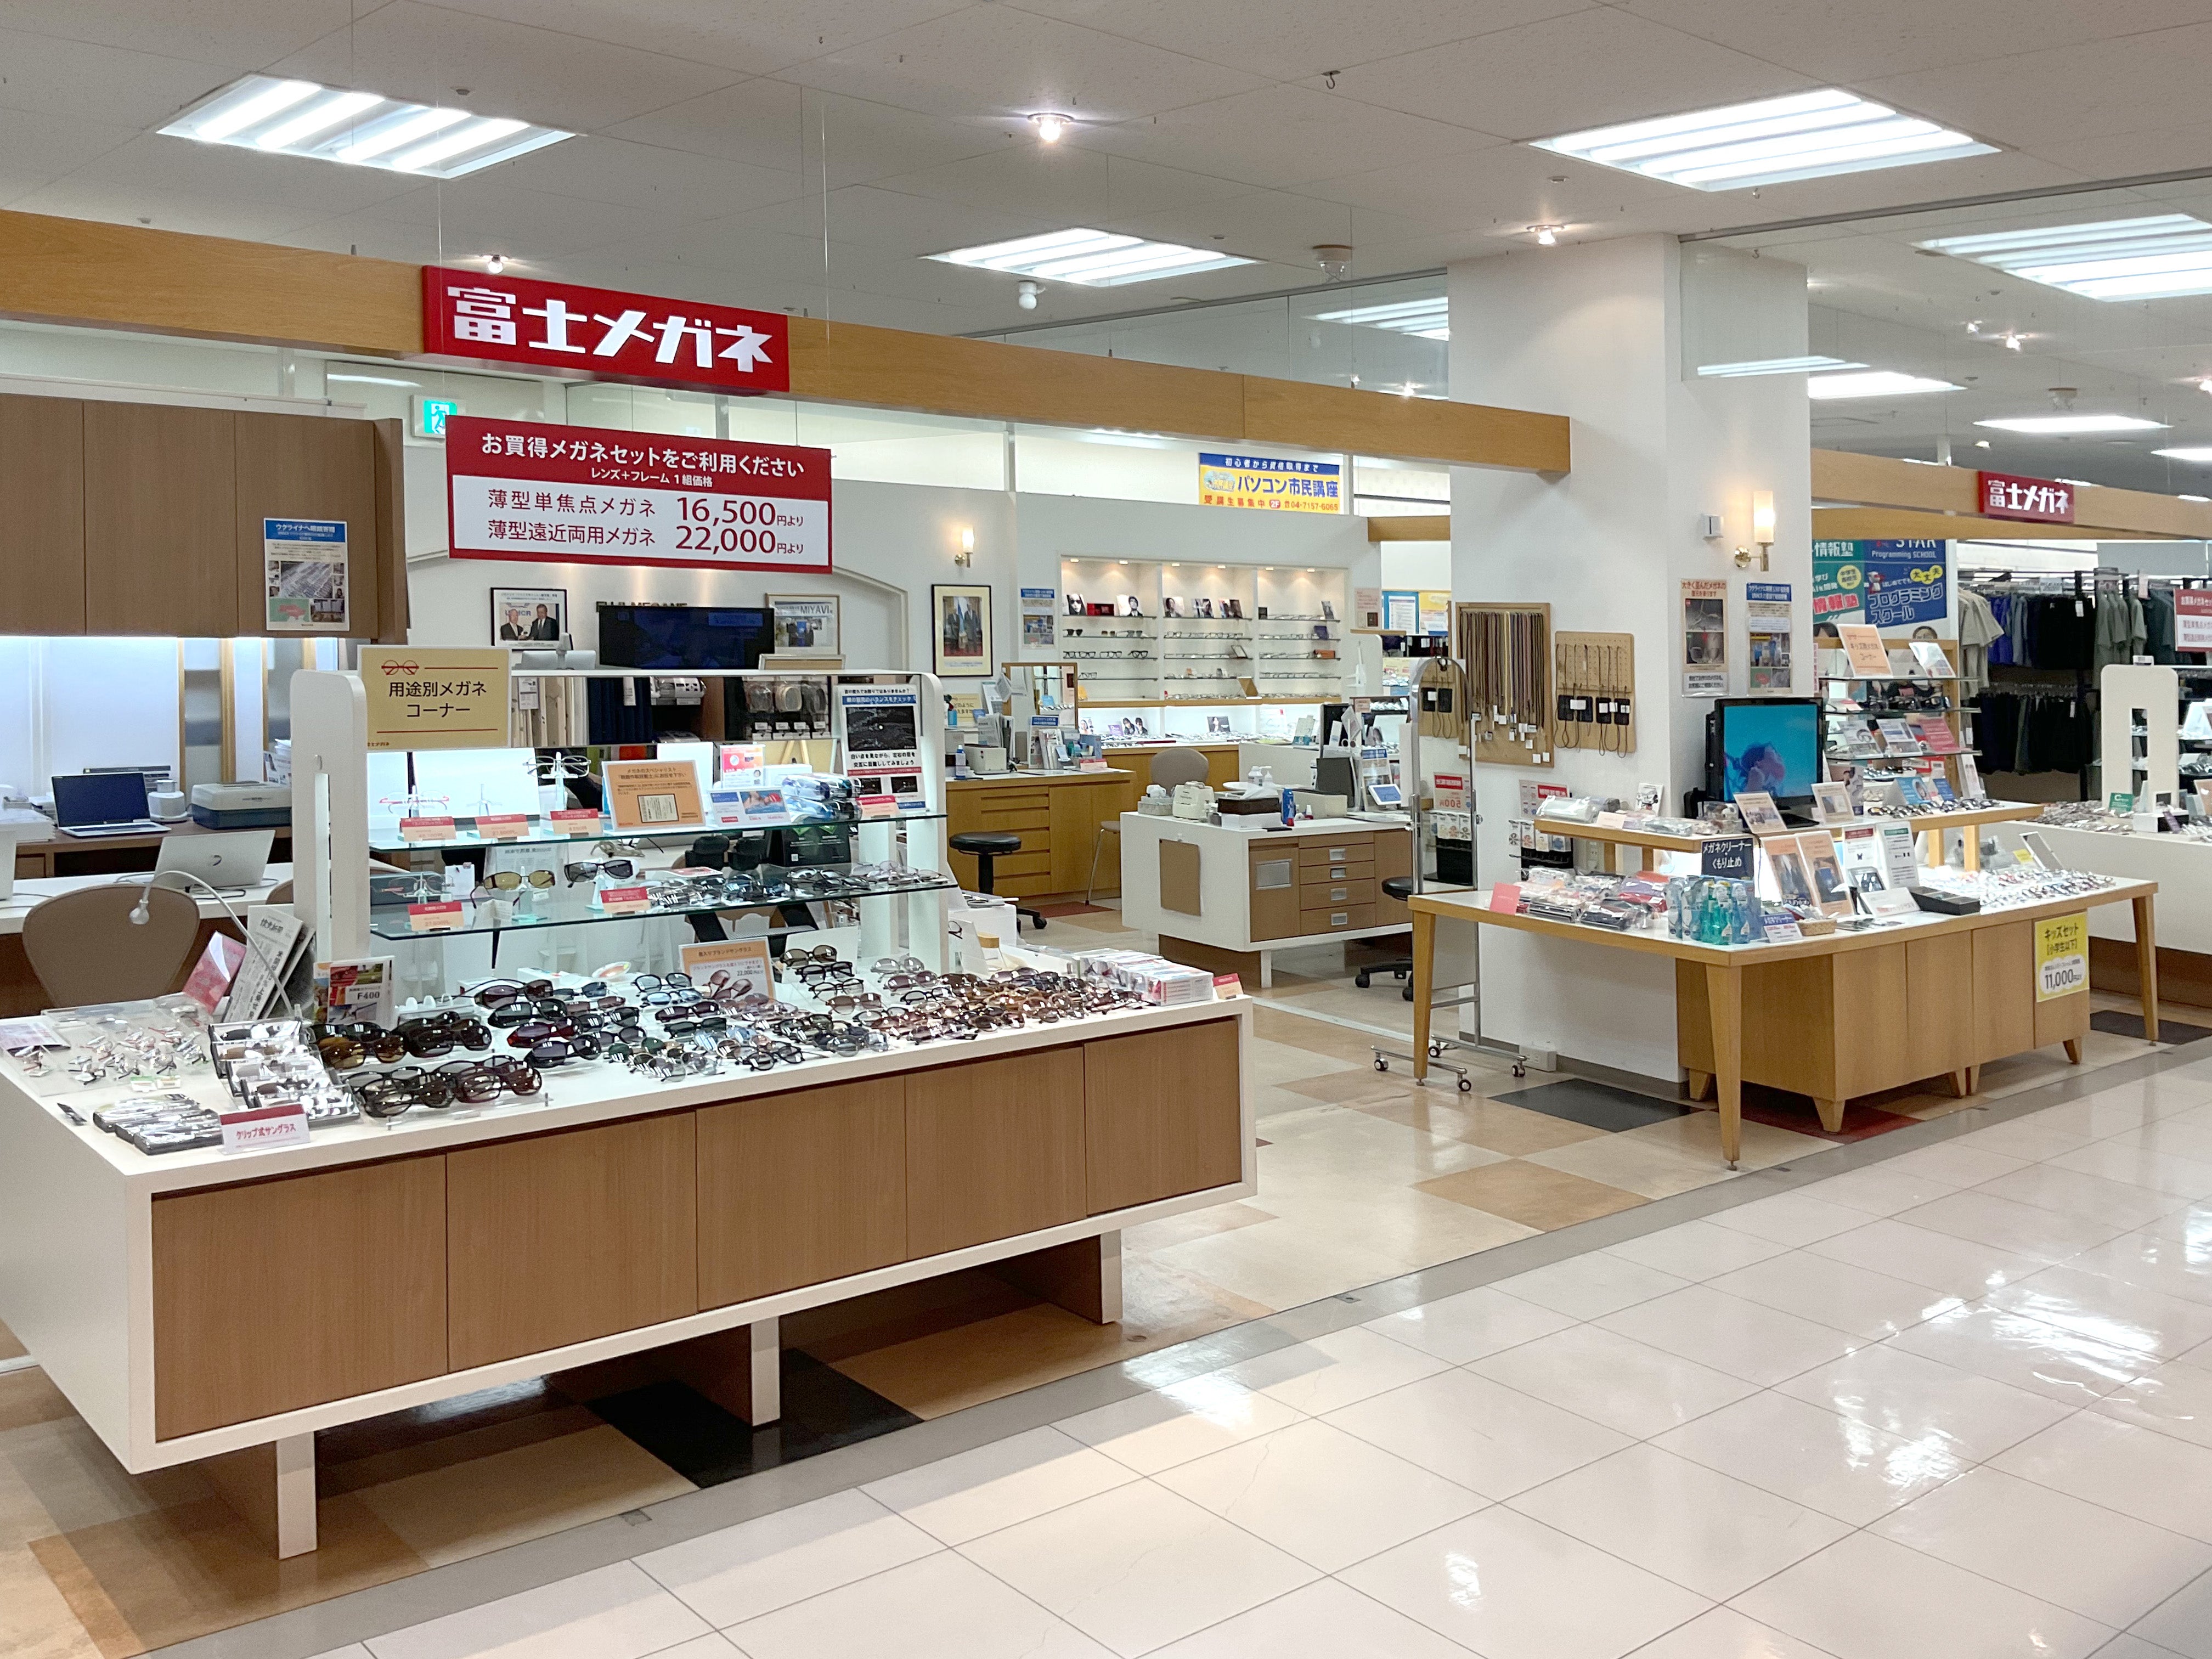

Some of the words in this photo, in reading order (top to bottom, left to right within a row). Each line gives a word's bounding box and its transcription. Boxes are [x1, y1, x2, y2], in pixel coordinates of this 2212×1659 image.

[447, 286, 774, 373] 富士メガネ
[481, 433, 804, 478] お買得メガネセットをご利用ください
[1224, 457, 1319, 472] 初心者から資格取得まで
[1238, 476, 1339, 498] パソコン市民講座
[488, 489, 656, 517] 薄型単焦点メガネ
[1270, 500, 1280, 508] 2F
[1988, 479, 2068, 515] 富士メガネ
[488, 519, 656, 547] 薄型遠近両用メガネ
[1871, 550, 1911, 559] Programming
[800, 605, 829, 614] MIYAVI
[1871, 605, 1915, 625] スクール
[389, 681, 487, 697] 用途別メガネ
[407, 703, 470, 718] コーナー
[1702, 840, 1752, 854] メガネクリーナー
[1712, 856, 1742, 869] くもり止め
[2045, 922, 2079, 941] キッズセット
[357, 991, 380, 1000] F400
[236, 1123, 296, 1140] クリップ式サングラス
